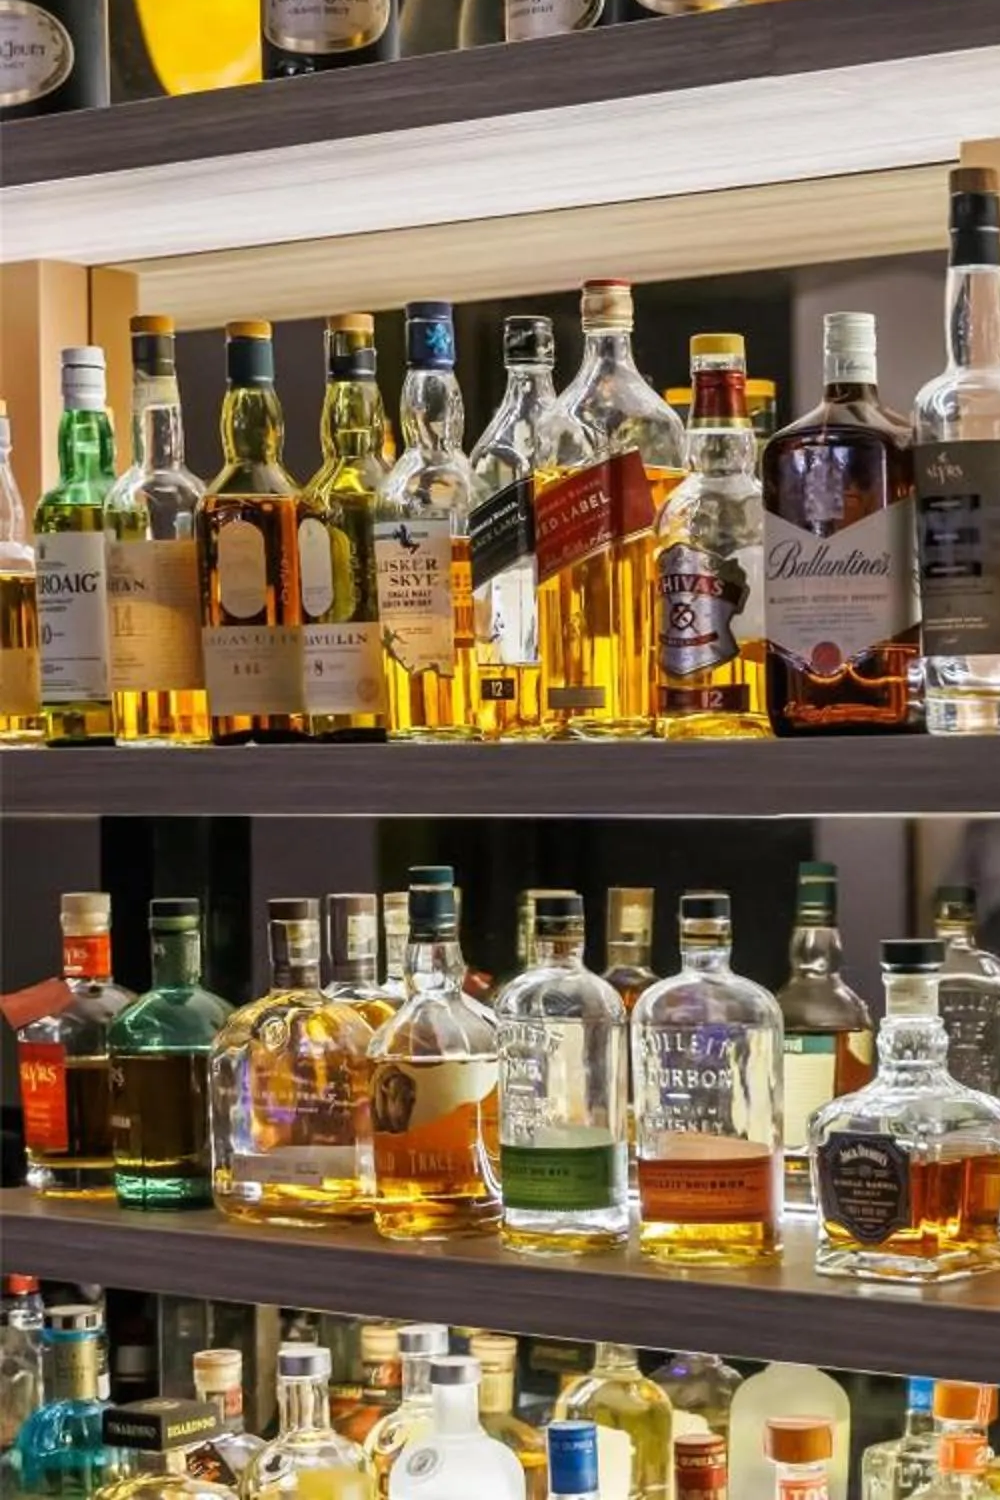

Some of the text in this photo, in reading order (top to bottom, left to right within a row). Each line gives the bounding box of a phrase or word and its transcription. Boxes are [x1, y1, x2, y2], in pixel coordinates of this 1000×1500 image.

[561, 490, 611, 523] LABEL
[766, 539, 894, 582] Ballantine's
[389, 573, 440, 588] SKYE
[662, 573, 726, 598] HIVAS
[490, 680, 504, 698] 12
[701, 688, 725, 709] 12
